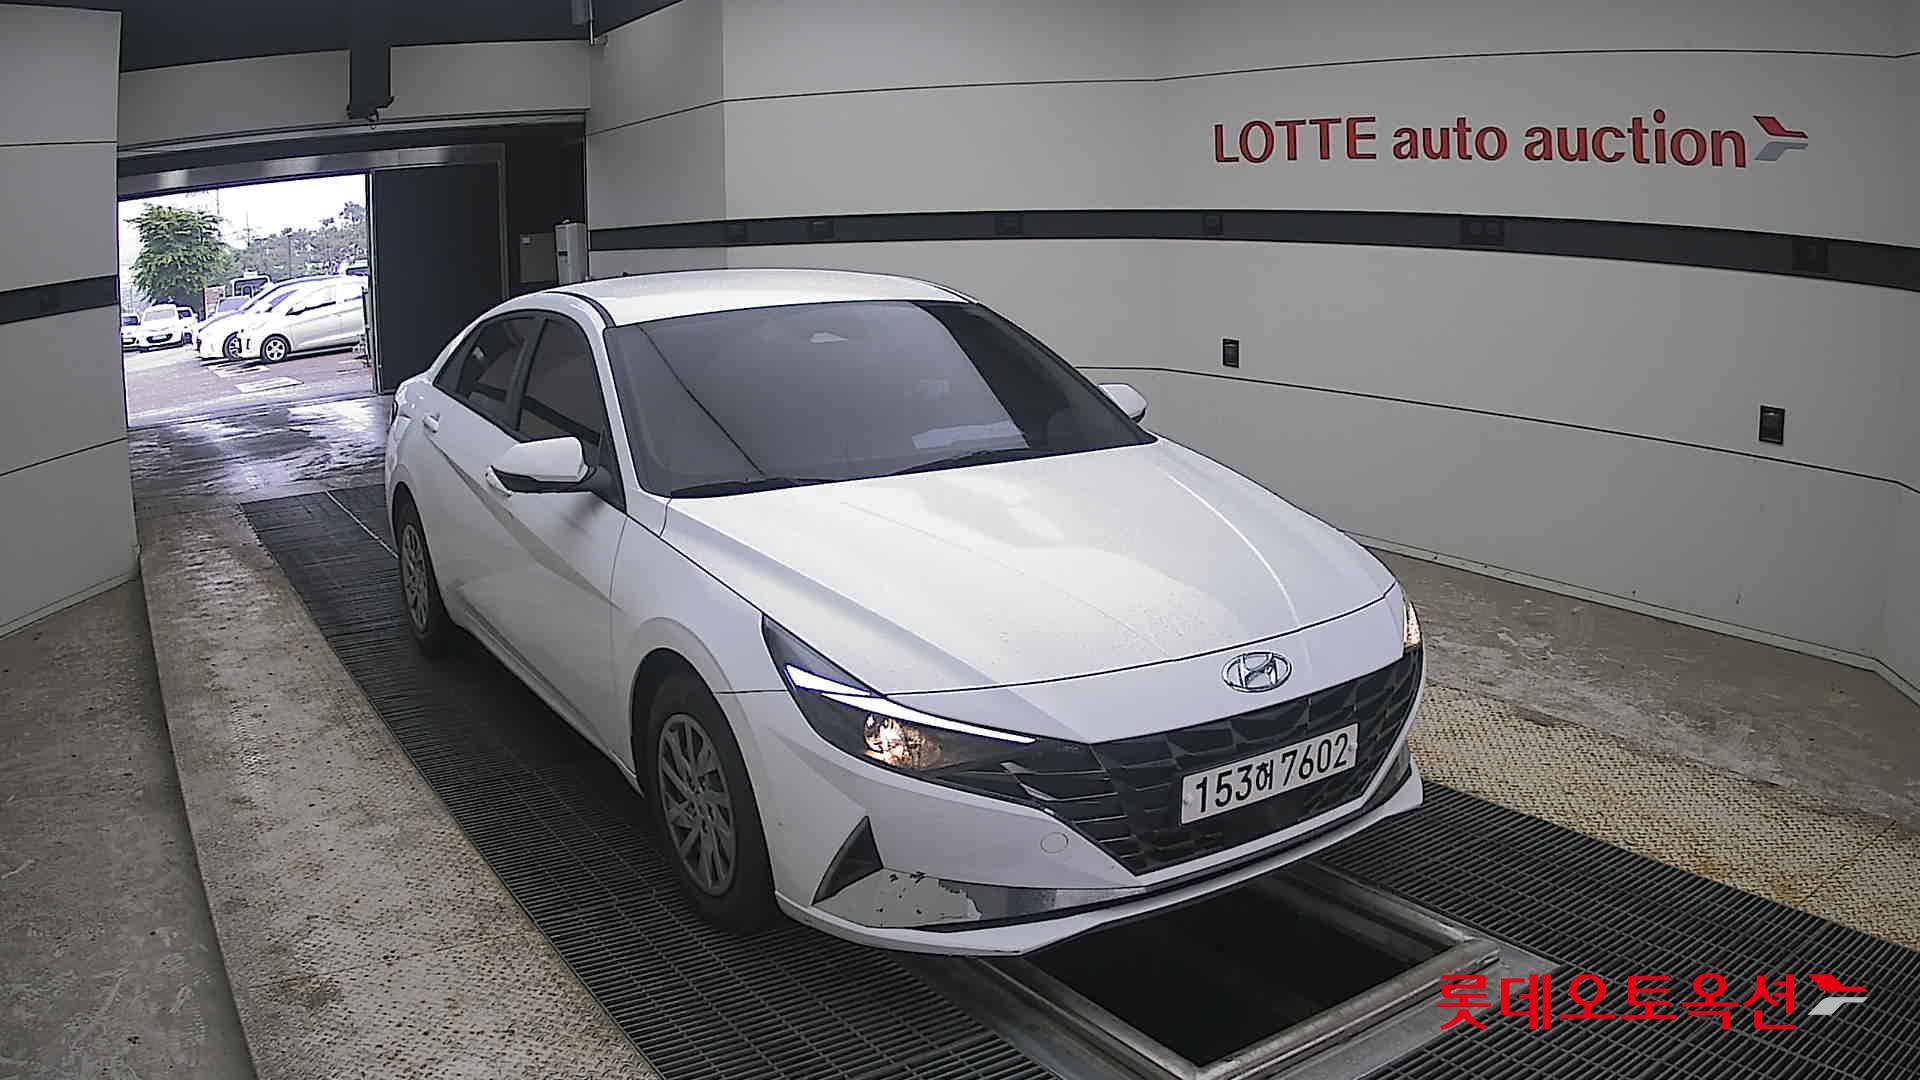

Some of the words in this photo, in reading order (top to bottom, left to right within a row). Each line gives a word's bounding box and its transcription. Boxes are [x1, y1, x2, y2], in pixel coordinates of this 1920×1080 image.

[1213, 116, 1377, 164] LOTTE
[1392, 116, 1509, 161] auto
[1523, 108, 1747, 168] auction
